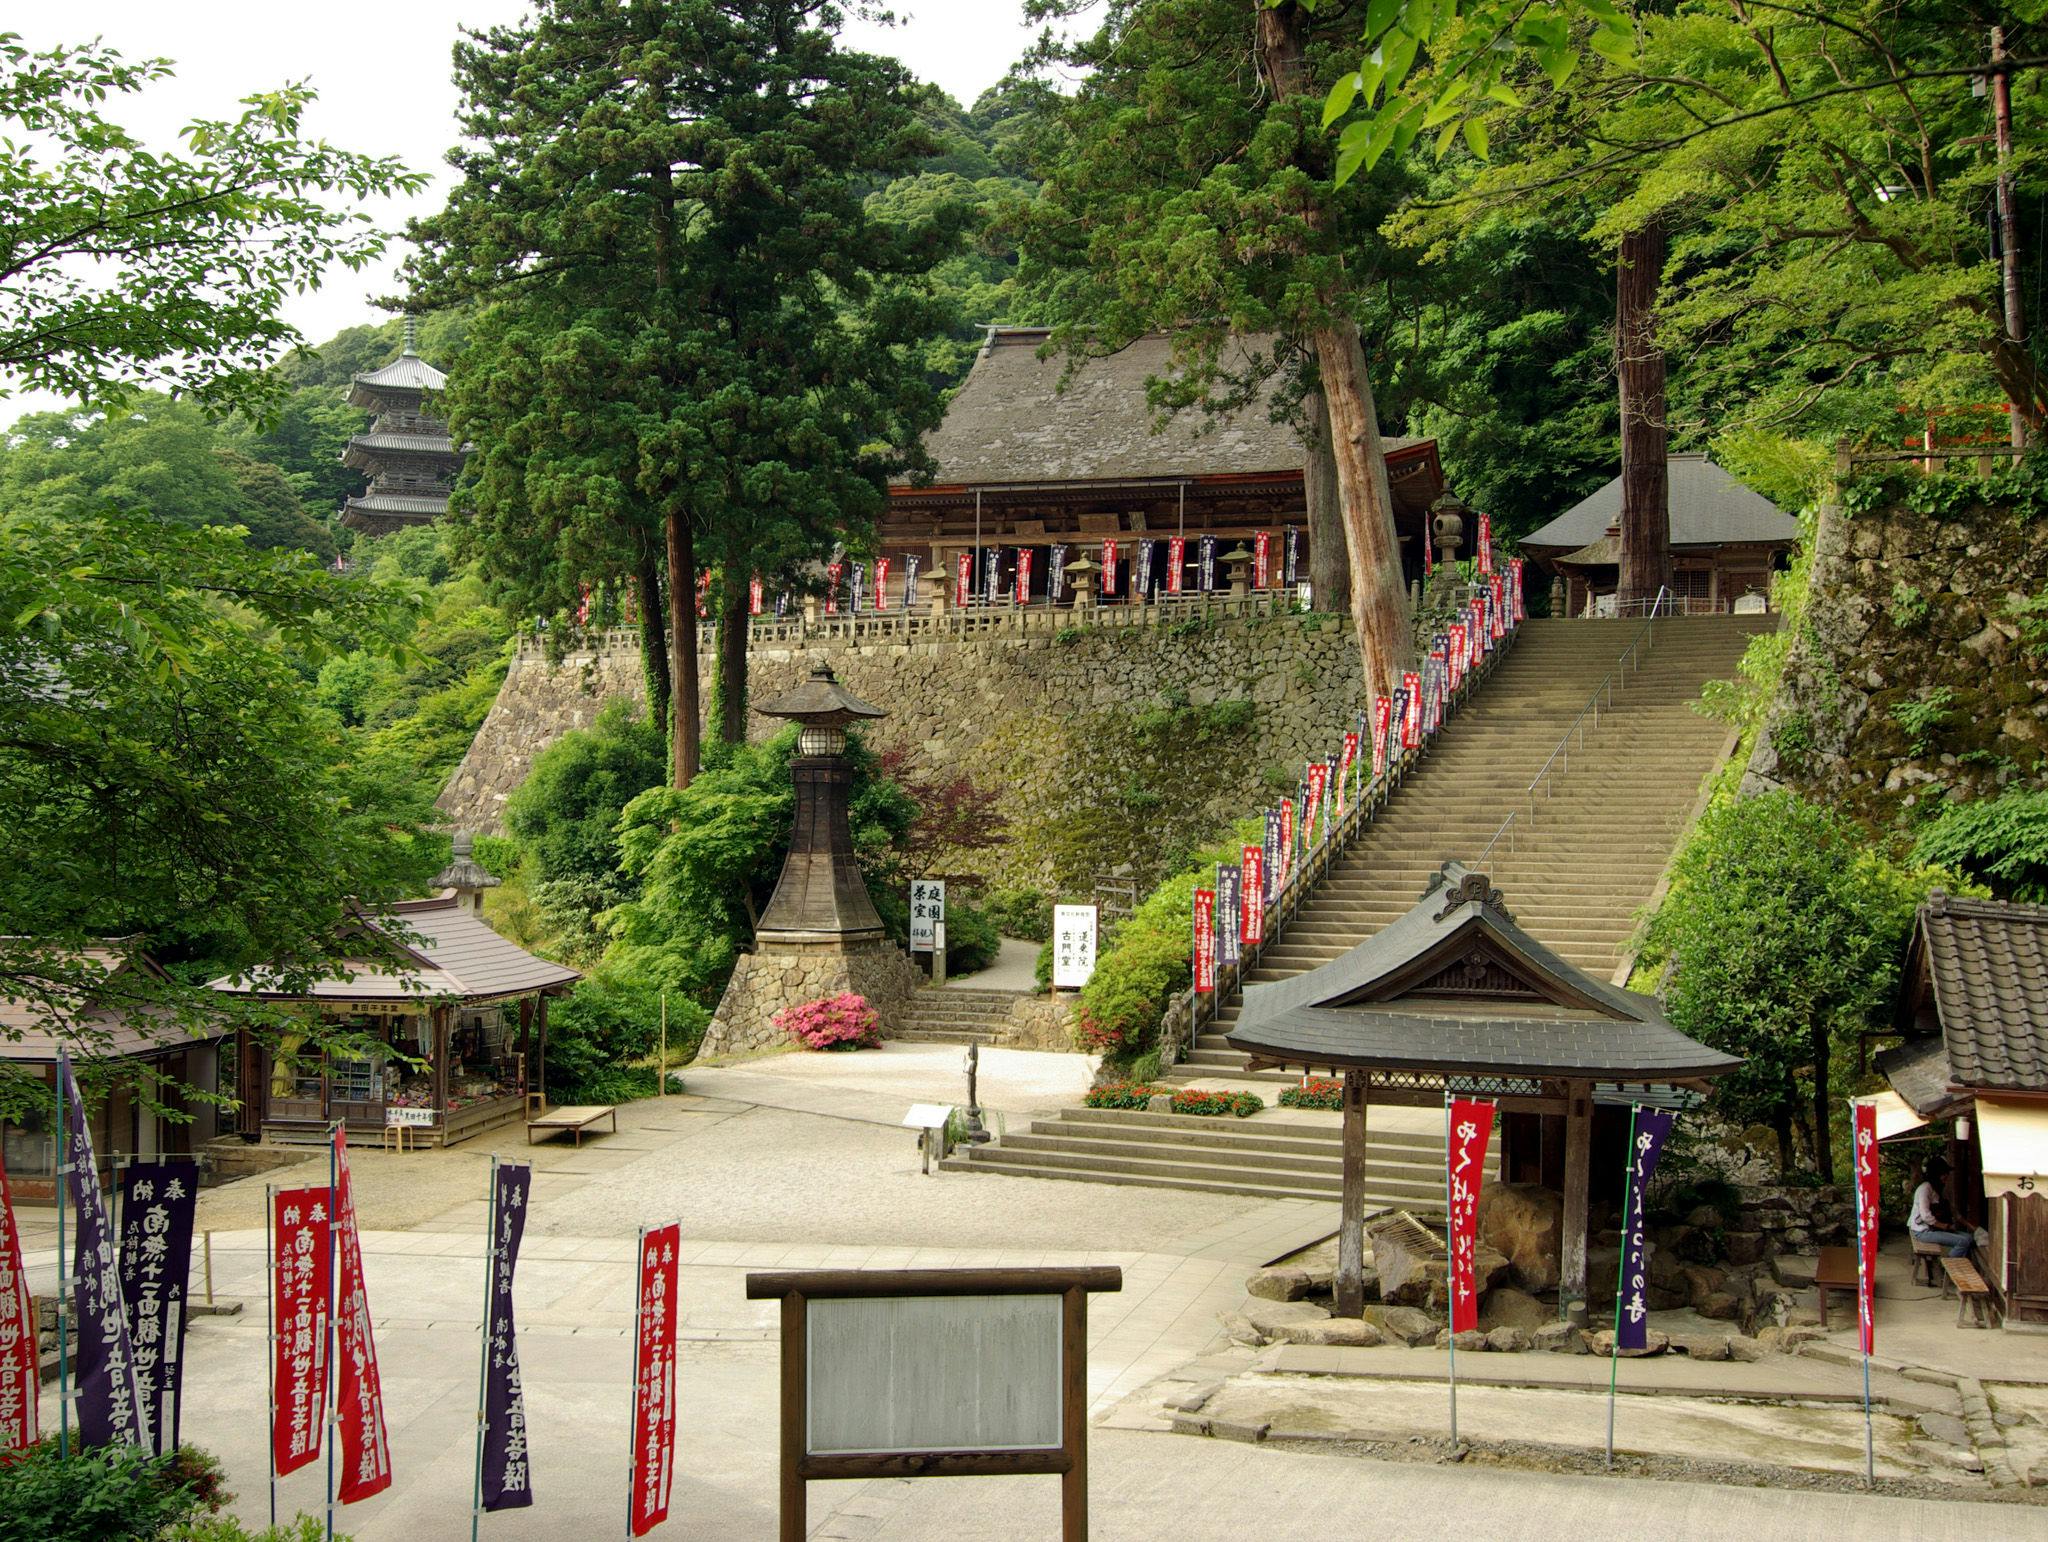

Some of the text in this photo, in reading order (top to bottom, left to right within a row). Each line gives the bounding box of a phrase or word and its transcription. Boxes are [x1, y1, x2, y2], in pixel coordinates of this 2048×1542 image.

[914, 884, 927, 918] 茶室
[927, 886, 942, 920] 庭園
[2018, 1176, 2034, 1190] お
